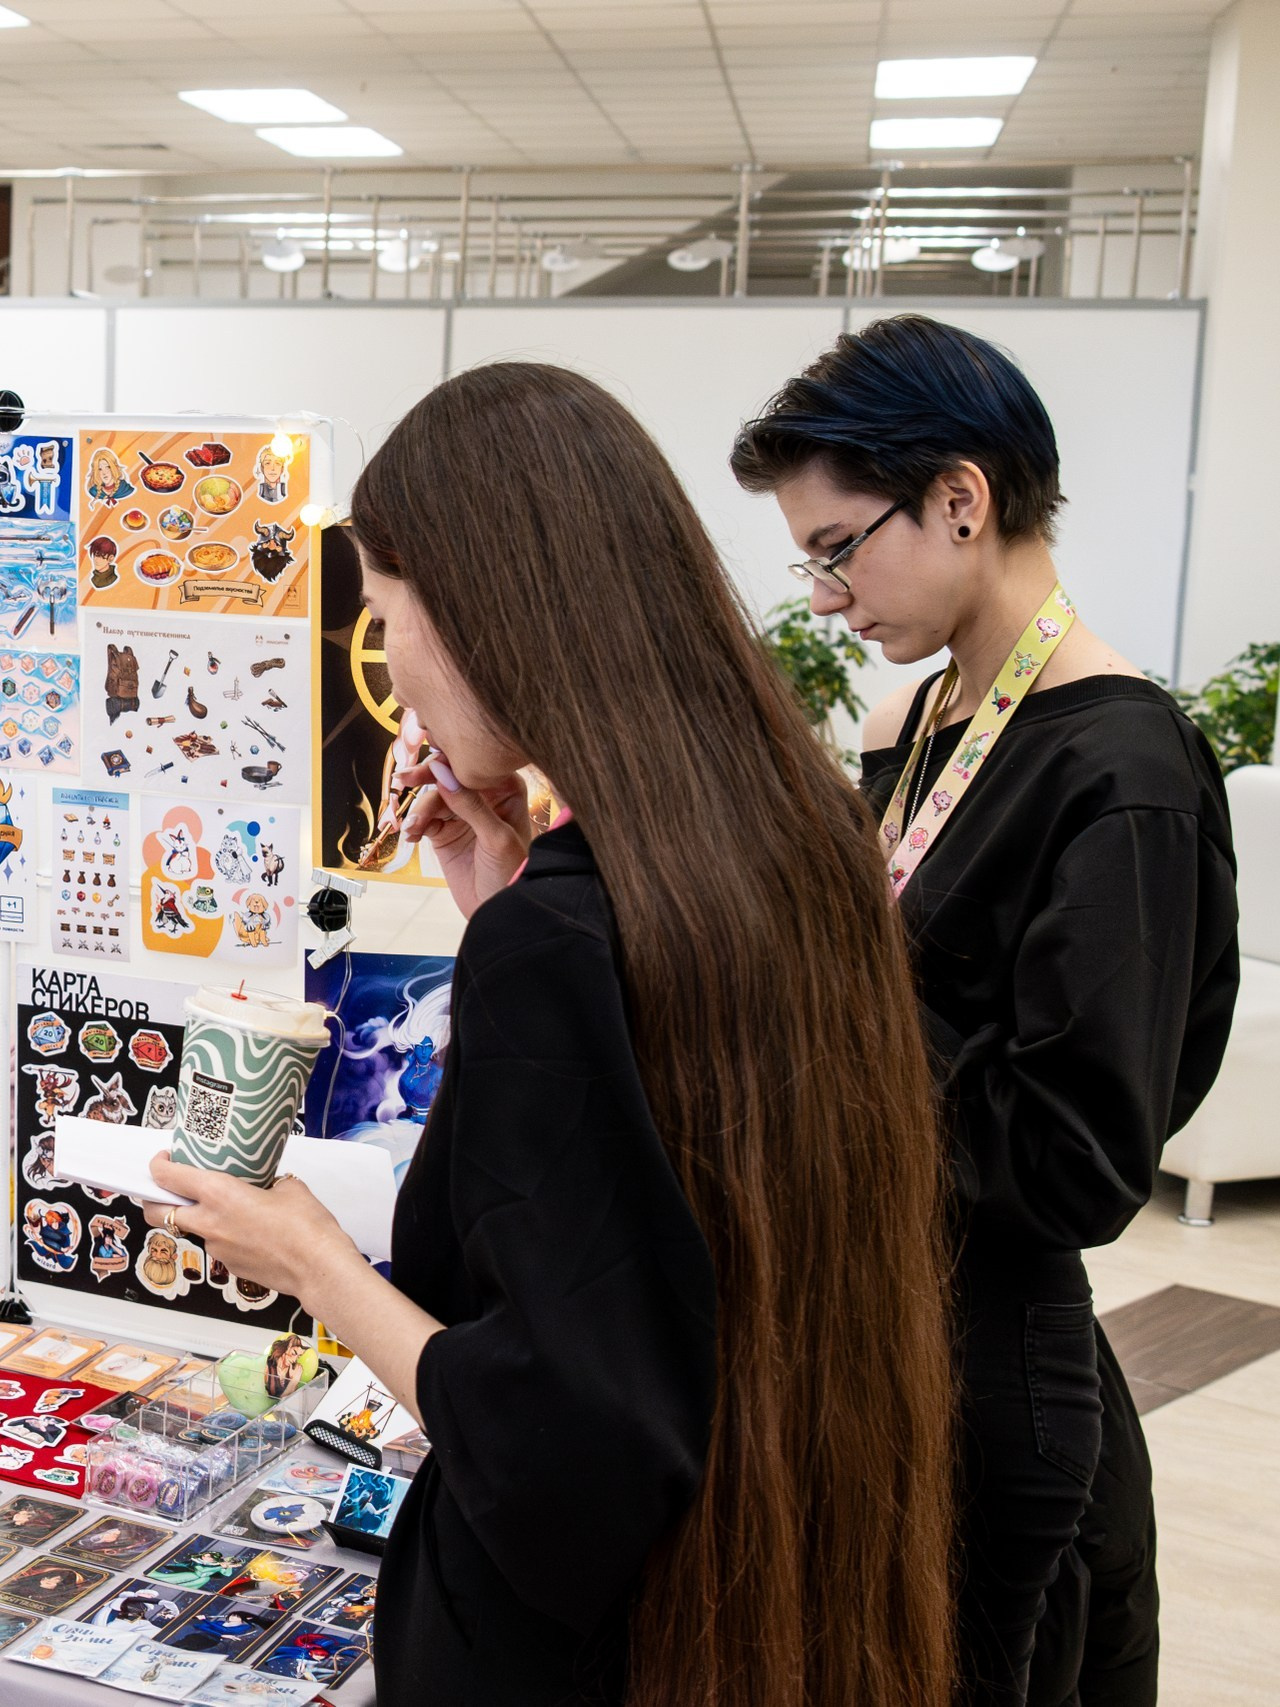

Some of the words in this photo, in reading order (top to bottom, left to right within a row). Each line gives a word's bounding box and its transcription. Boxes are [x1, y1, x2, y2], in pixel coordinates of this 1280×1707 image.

[225, 586, 253, 594] вкусностей
[102, 626, 124, 636] Набор
[126, 630, 191, 640] путешественника
[7, 901, 17, 909] +1
[32, 968, 101, 999] КАРТА
[31, 988, 151, 1021] СТИКЕРОВ
[44, 1029, 53, 1038] 20
[94, 1037, 104, 1046] 20
[36, 1256, 56, 1270] wizard
